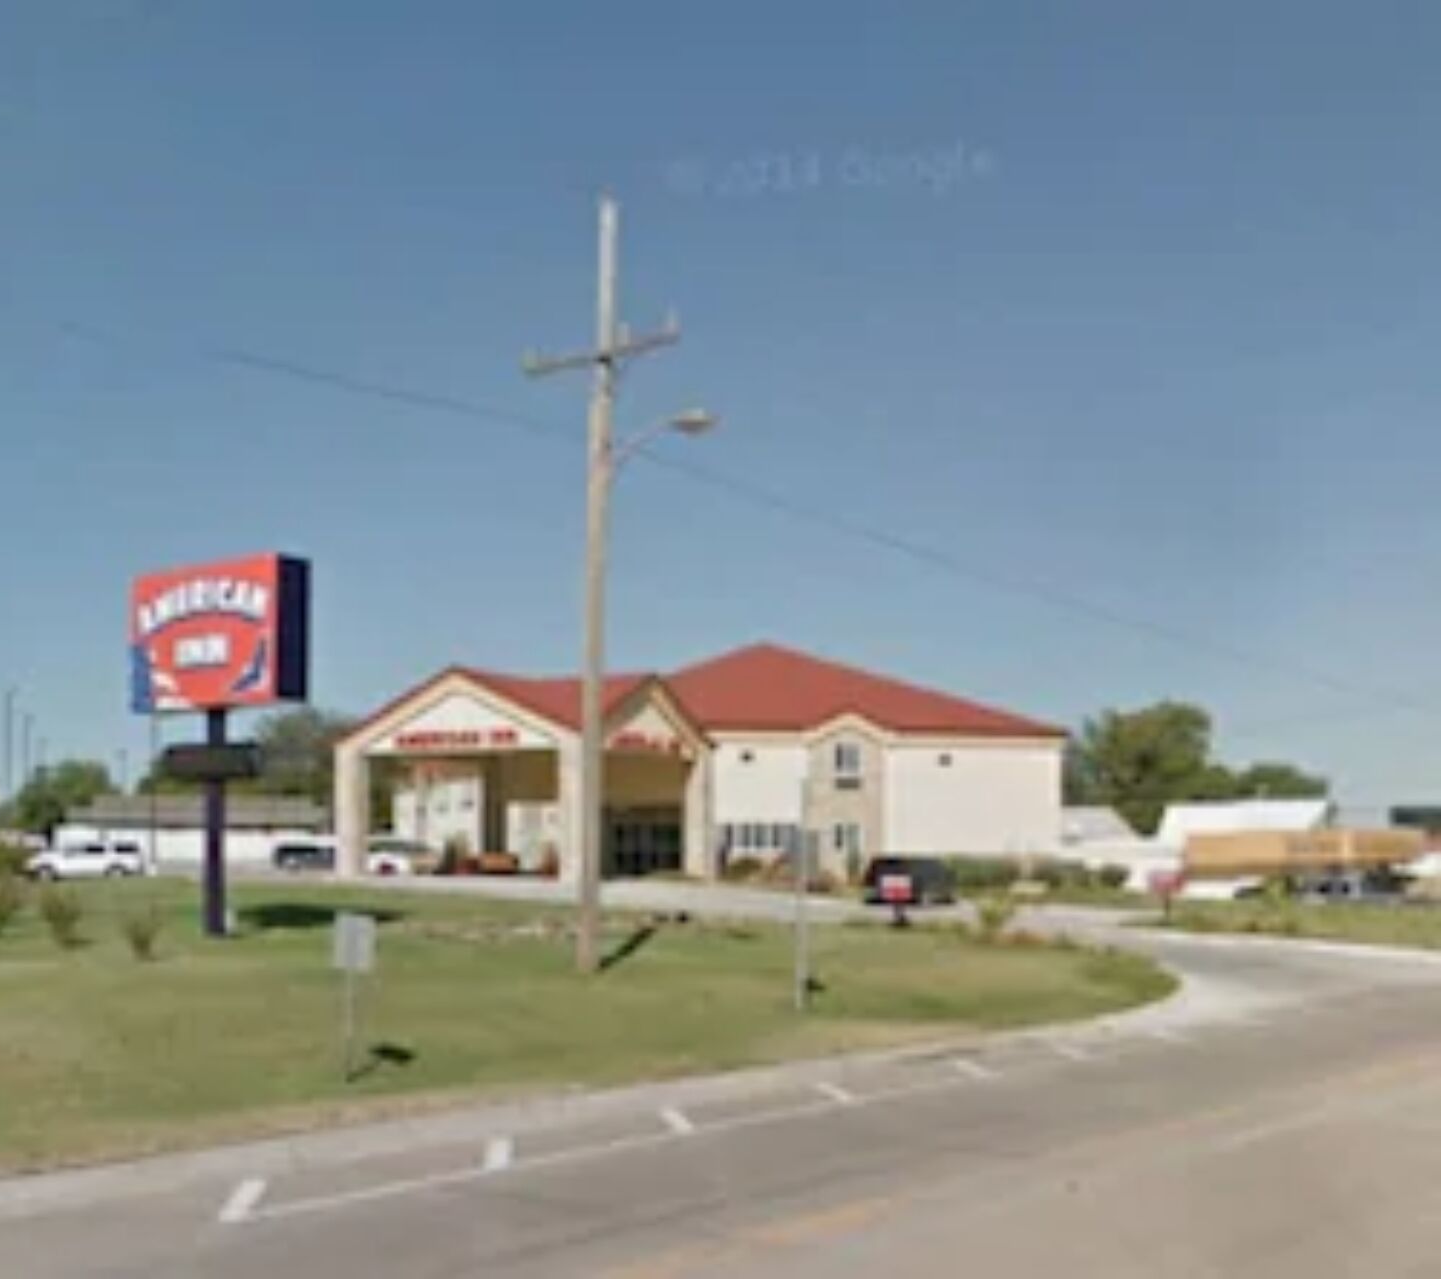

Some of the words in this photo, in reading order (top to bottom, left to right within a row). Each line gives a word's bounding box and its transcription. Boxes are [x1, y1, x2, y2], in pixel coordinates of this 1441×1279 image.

[136, 578, 268, 634] AMERICAN
[174, 635, 229, 668] INN
[394, 729, 481, 748] AMERICAN
